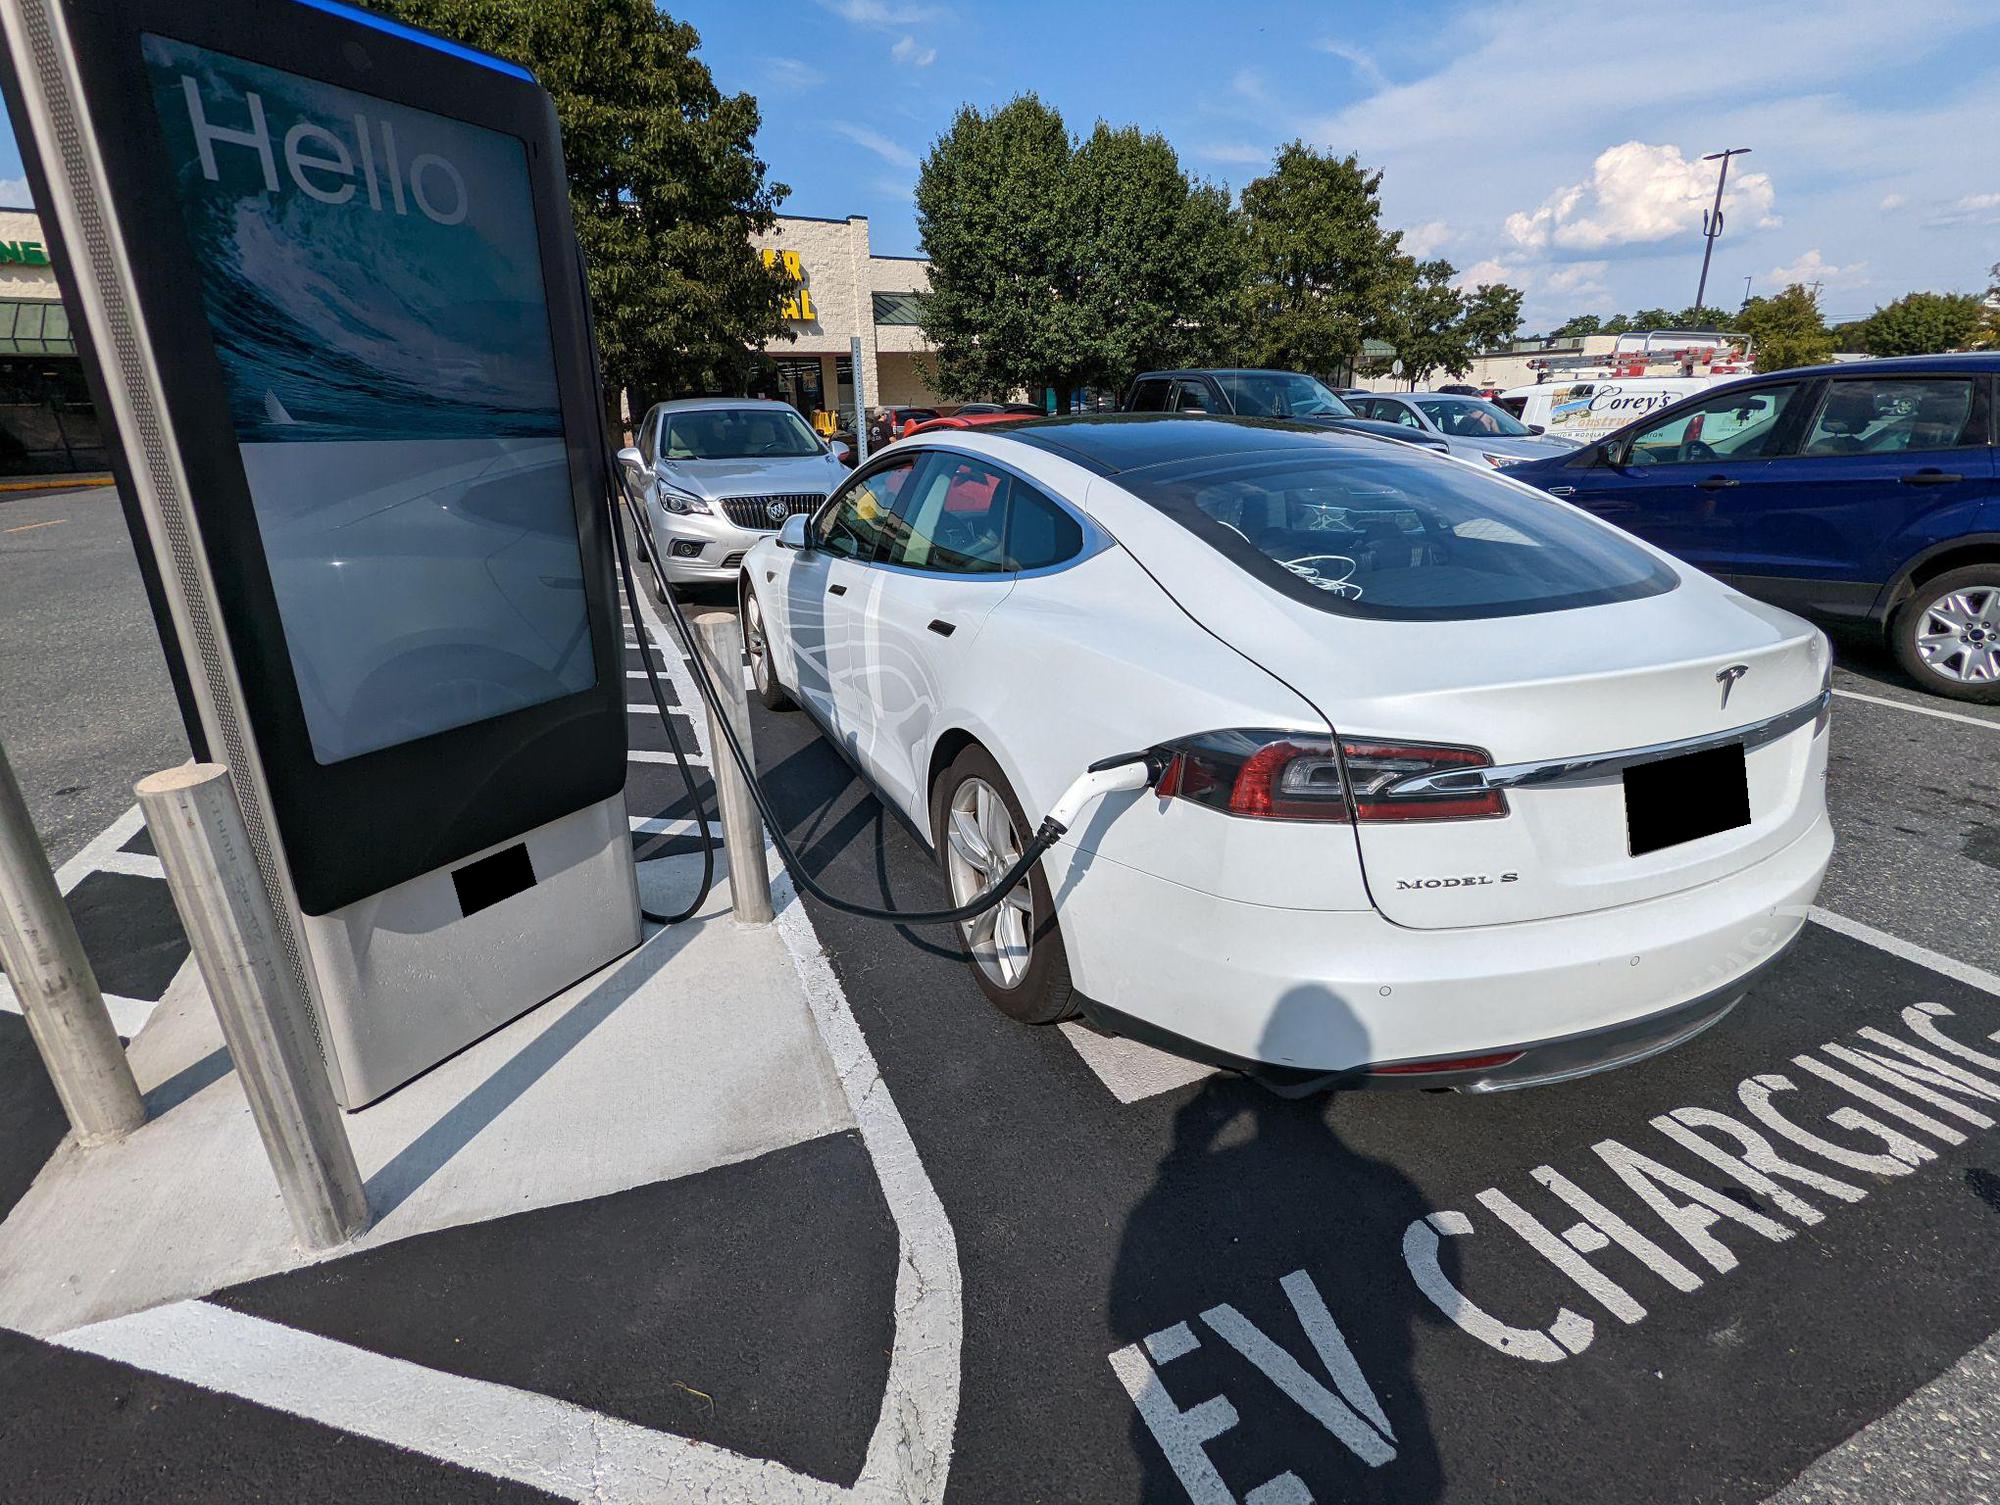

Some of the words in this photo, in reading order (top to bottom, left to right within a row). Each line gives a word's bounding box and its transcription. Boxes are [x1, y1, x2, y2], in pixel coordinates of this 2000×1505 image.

[181, 74, 468, 226] Hello
[1587, 384, 1671, 415] Corey's
[1396, 875, 1494, 890] MODEL
[1499, 872, 1519, 883] S
[1107, 1268, 1398, 1505] EV
